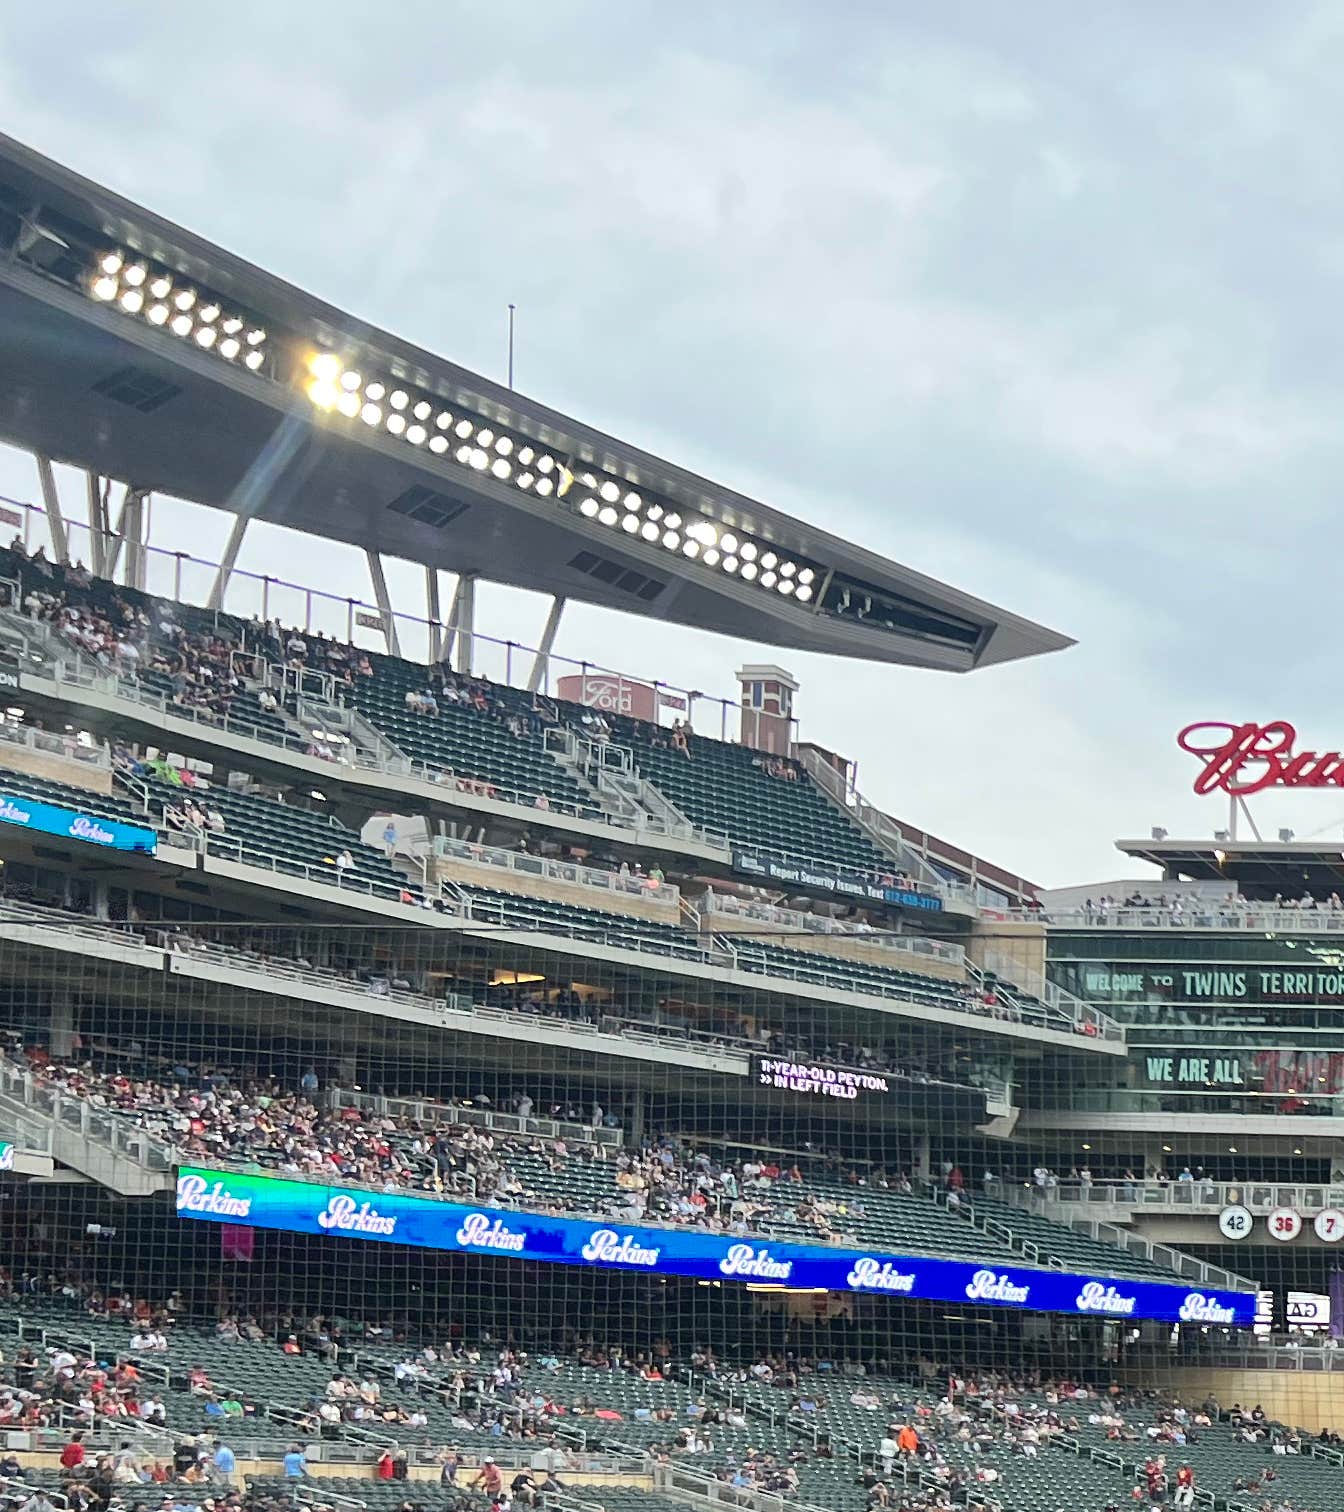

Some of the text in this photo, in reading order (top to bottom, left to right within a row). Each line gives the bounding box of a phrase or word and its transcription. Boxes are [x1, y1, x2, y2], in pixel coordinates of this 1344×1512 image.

[579, 680, 632, 713] Ford
[1086, 973, 1144, 993] WELCOME
[1151, 975, 1174, 987] TO
[1182, 972, 1247, 997] TWINS
[774, 1075, 788, 1089] IN
[790, 1077, 820, 1093] LEFT
[822, 1081, 858, 1099] FIELD
[1147, 1057, 1174, 1082] WE
[1179, 1058, 1210, 1083] ARE
[1213, 1059, 1244, 1084] ALL
[177, 1175, 251, 1217] Perkins
[319, 1194, 397, 1236] Perkins
[1225, 1215, 1245, 1230] 42
[1275, 1216, 1293, 1232] 36
[1325, 1218, 1336, 1233] 7
[457, 1213, 526, 1252] Perkins
[582, 1229, 660, 1266] Perkins
[720, 1243, 791, 1279] Perkins
[847, 1257, 915, 1291] Perkins
[966, 1269, 1029, 1303] Perkins
[1076, 1281, 1136, 1314] Perkins
[1180, 1294, 1234, 1325] Perkins
